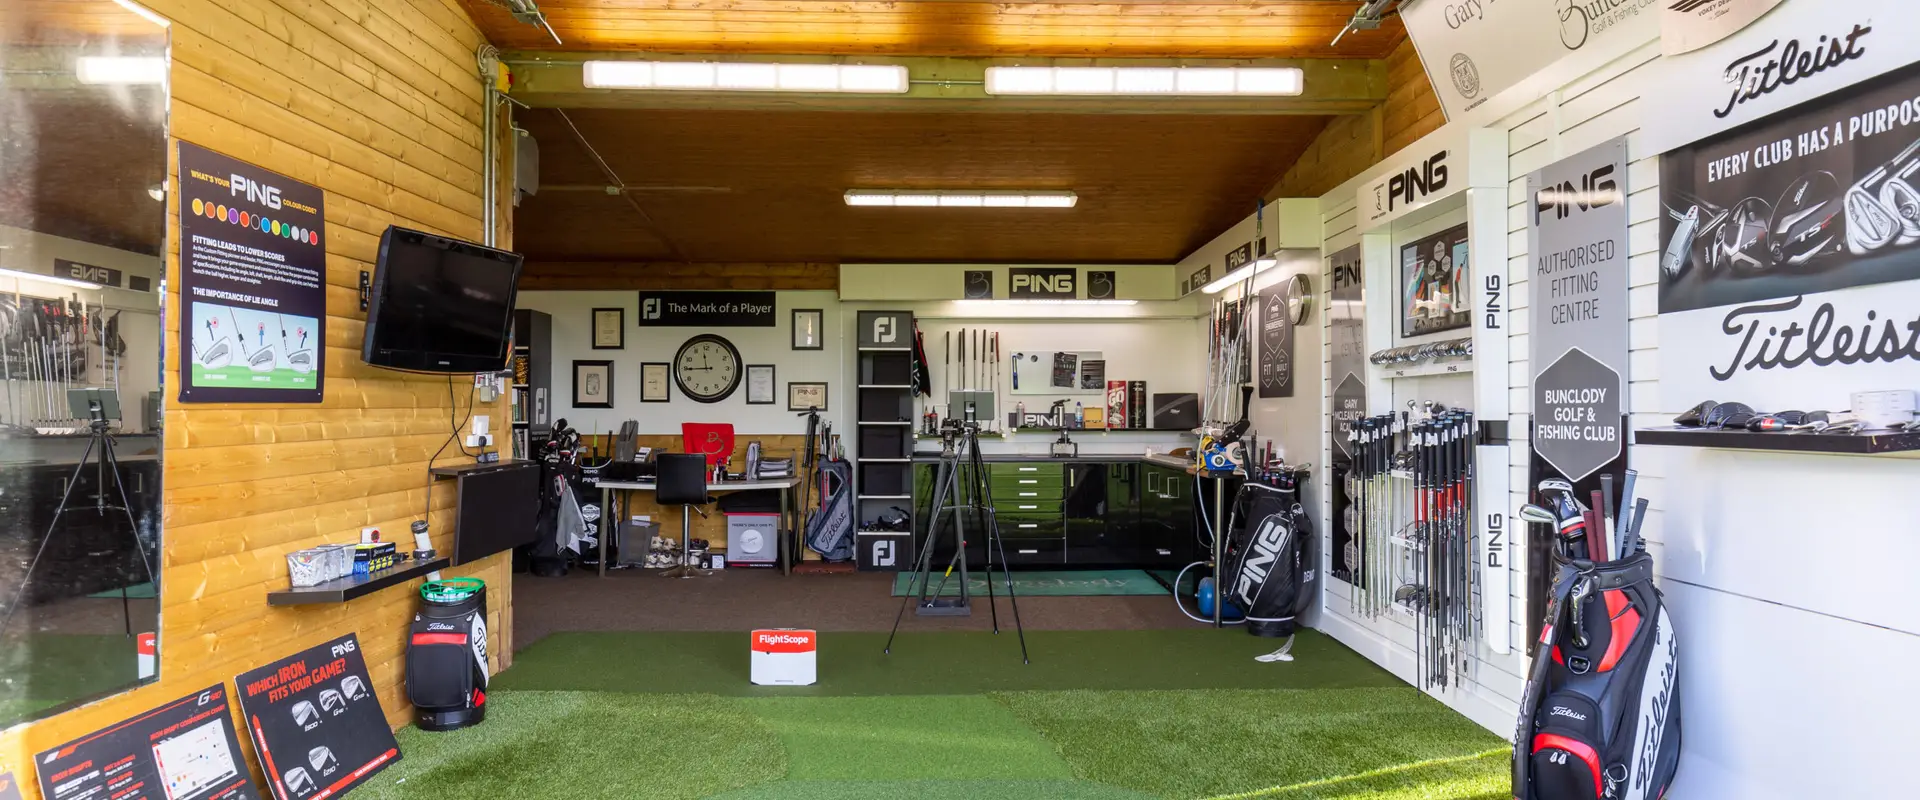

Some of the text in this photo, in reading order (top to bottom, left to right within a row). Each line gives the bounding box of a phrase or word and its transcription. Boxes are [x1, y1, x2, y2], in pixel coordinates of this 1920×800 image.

[1592, 4, 1639, 34] Golf & Fishing
[1698, 4, 1717, 16] VOKEY
[1713, 24, 1872, 118] Titleist
[1708, 96, 1920, 183] EVERY CLUB HAS A PURPOS
[190, 169, 230, 188] WHAT'S YOUR
[230, 173, 282, 211] PING
[1389, 150, 1448, 212] PING
[1534, 164, 1616, 227] PING
[192, 234, 286, 262] FITTING LEADS TO LOWER SCORES
[1230, 248, 1246, 269] PING
[1537, 239, 1616, 276] AUTHORISED
[1012, 274, 1073, 293] PING
[1334, 259, 1362, 290] PIN
[1551, 270, 1598, 299] FITTING
[192, 286, 278, 307] THE IMPORTANCE OF LIE ANGLE
[642, 298, 661, 320] FJ
[668, 302, 688, 313] The
[690, 302, 717, 313] Mark
[719, 302, 730, 313] of
[740, 303, 772, 315] Player
[1486, 274, 1500, 330] PING
[1551, 298, 1600, 325] CENTRE
[874, 316, 896, 343] FJ
[1277, 363, 1287, 372] BUILT
[535, 387, 548, 425] FJ
[1108, 390, 1124, 407] GO
[1344, 399, 1358, 408] GARY
[1545, 388, 1607, 404] BUNCLODY
[1554, 407, 1596, 422] GOLF &
[1538, 425, 1616, 442] FISHING CLUB
[820, 510, 847, 549] Titleist
[1488, 513, 1503, 568] PING
[872, 540, 896, 567] FJ
[1404, 540, 1414, 549] PING
[1238, 521, 1287, 606] PING
[1303, 569, 1315, 583] DEMO
[427, 622, 455, 631] Titleist
[1405, 609, 1414, 617] PING
[331, 640, 356, 658] PING
[759, 635, 809, 645] FlightScope
[246, 660, 307, 697] WHICH IRON
[268, 657, 346, 704] FITS YOUR GAME?
[1549, 704, 1587, 721] Titleist
[1636, 633, 1678, 796] Titleist
